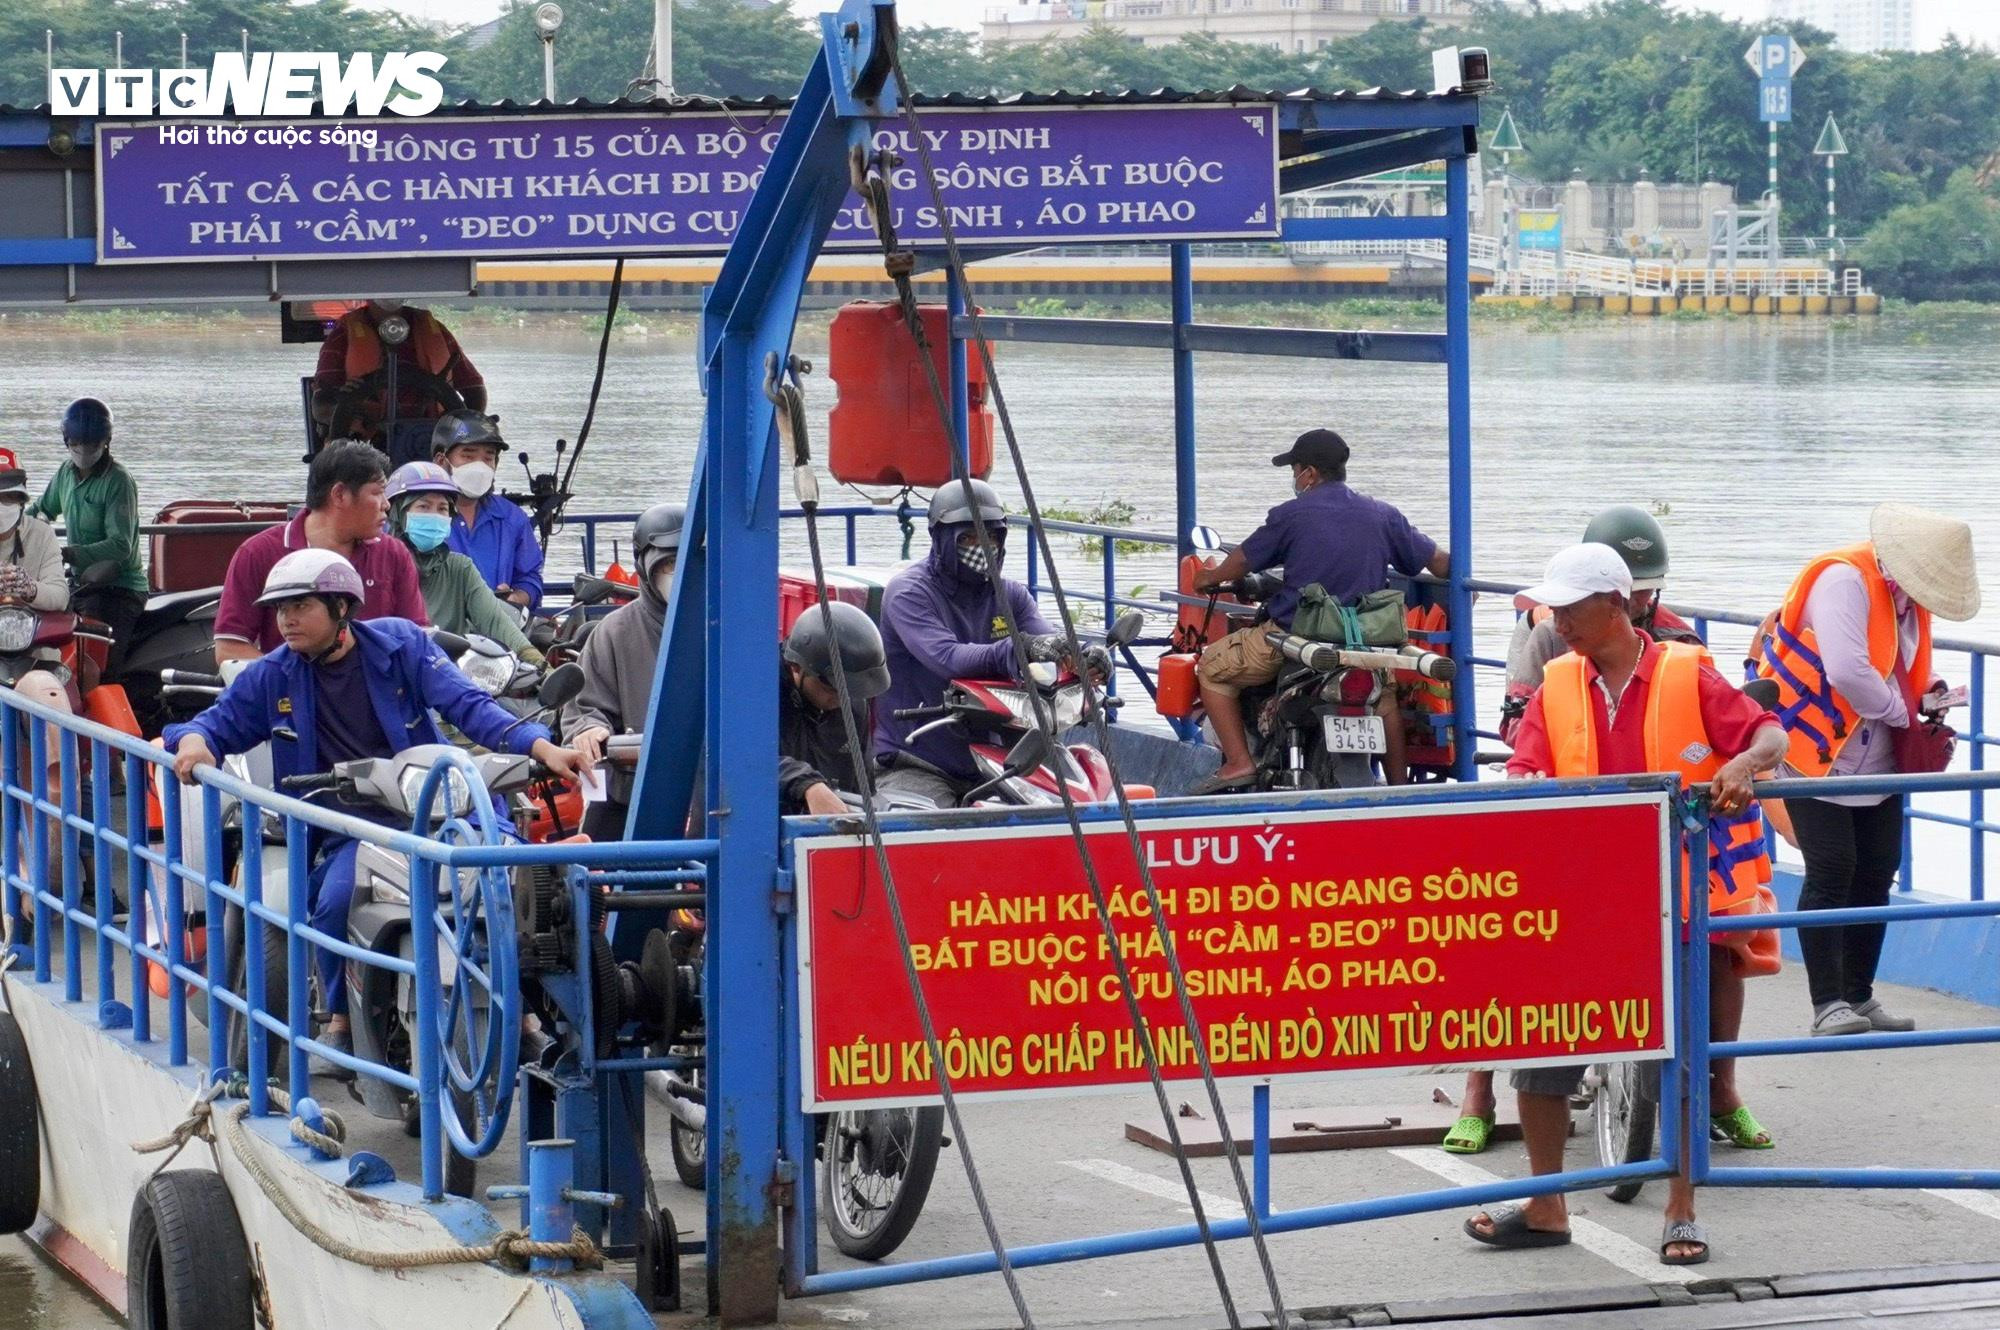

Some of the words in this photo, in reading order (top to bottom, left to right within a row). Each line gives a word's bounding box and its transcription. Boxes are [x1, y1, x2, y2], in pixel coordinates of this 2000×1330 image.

[1766, 44, 1786, 69] P
[342, 133, 477, 163] THÔNG
[488, 132, 542, 159] TƯ
[553, 136, 595, 158] 15
[608, 126, 686, 157] CỦA
[696, 126, 747, 159] BỘ
[871, 130, 949, 155] QUY
[960, 127, 1051, 155] ĐỊNH
[157, 171, 234, 204] TẤT
[246, 173, 299, 204] CẢ
[312, 173, 391, 202] CÁC
[403, 172, 513, 201] HÀNH
[525, 168, 660, 197] KHÁCH
[671, 172, 711, 194] ĐI
[932, 161, 1029, 190] SÔNG
[1040, 154, 1113, 187] BẮT
[1124, 155, 1224, 188] BUỘC
[189, 212, 282, 244] PHẢI
[567, 211, 676, 240] DỤNG
[688, 210, 739, 236] CỤ
[915, 205, 1003, 229] SNH
[1036, 197, 1087, 225] ÁO
[1098, 200, 1196, 223] PHAO
[1335, 734, 1377, 751] 3456
[1147, 835, 1239, 868] LƯU
[1253, 826, 1295, 862] Ý:
[950, 892, 1046, 927] HÀNH
[1057, 884, 1177, 921] KHÁCH
[1186, 886, 1221, 914] ĐI
[1230, 876, 1281, 912] ĐÒ
[1290, 876, 1413, 909] NGANG
[1422, 866, 1519, 902] SÔNG
[910, 936, 979, 971] BẮT
[988, 932, 1087, 970] BUỘC
[1098, 924, 1177, 961] PHẢI
[1407, 912, 1503, 949] DỤNG
[1512, 909, 1559, 942] CỤ
[1098, 966, 1173, 1002] CỨU
[1184, 966, 1272, 998] SINH,
[1281, 957, 1333, 992] ÁO
[1342, 956, 1446, 988] PHAO.
[828, 1034, 892, 1087] NẾU
[901, 1027, 1014, 1083] KHÔNG
[1021, 1021, 1107, 1075] CHẤP
[1209, 1012, 1271, 1064] BẾN
[1278, 1006, 1325, 1060] ĐÒ
[1331, 1013, 1380, 1057] XIN
[1388, 1001, 1433, 1053] TỪ
[1440, 997, 1512, 1050] CHỐI
[1521, 1000, 1603, 1053] PHỤC
[1609, 998, 1650, 1048] VỤ
